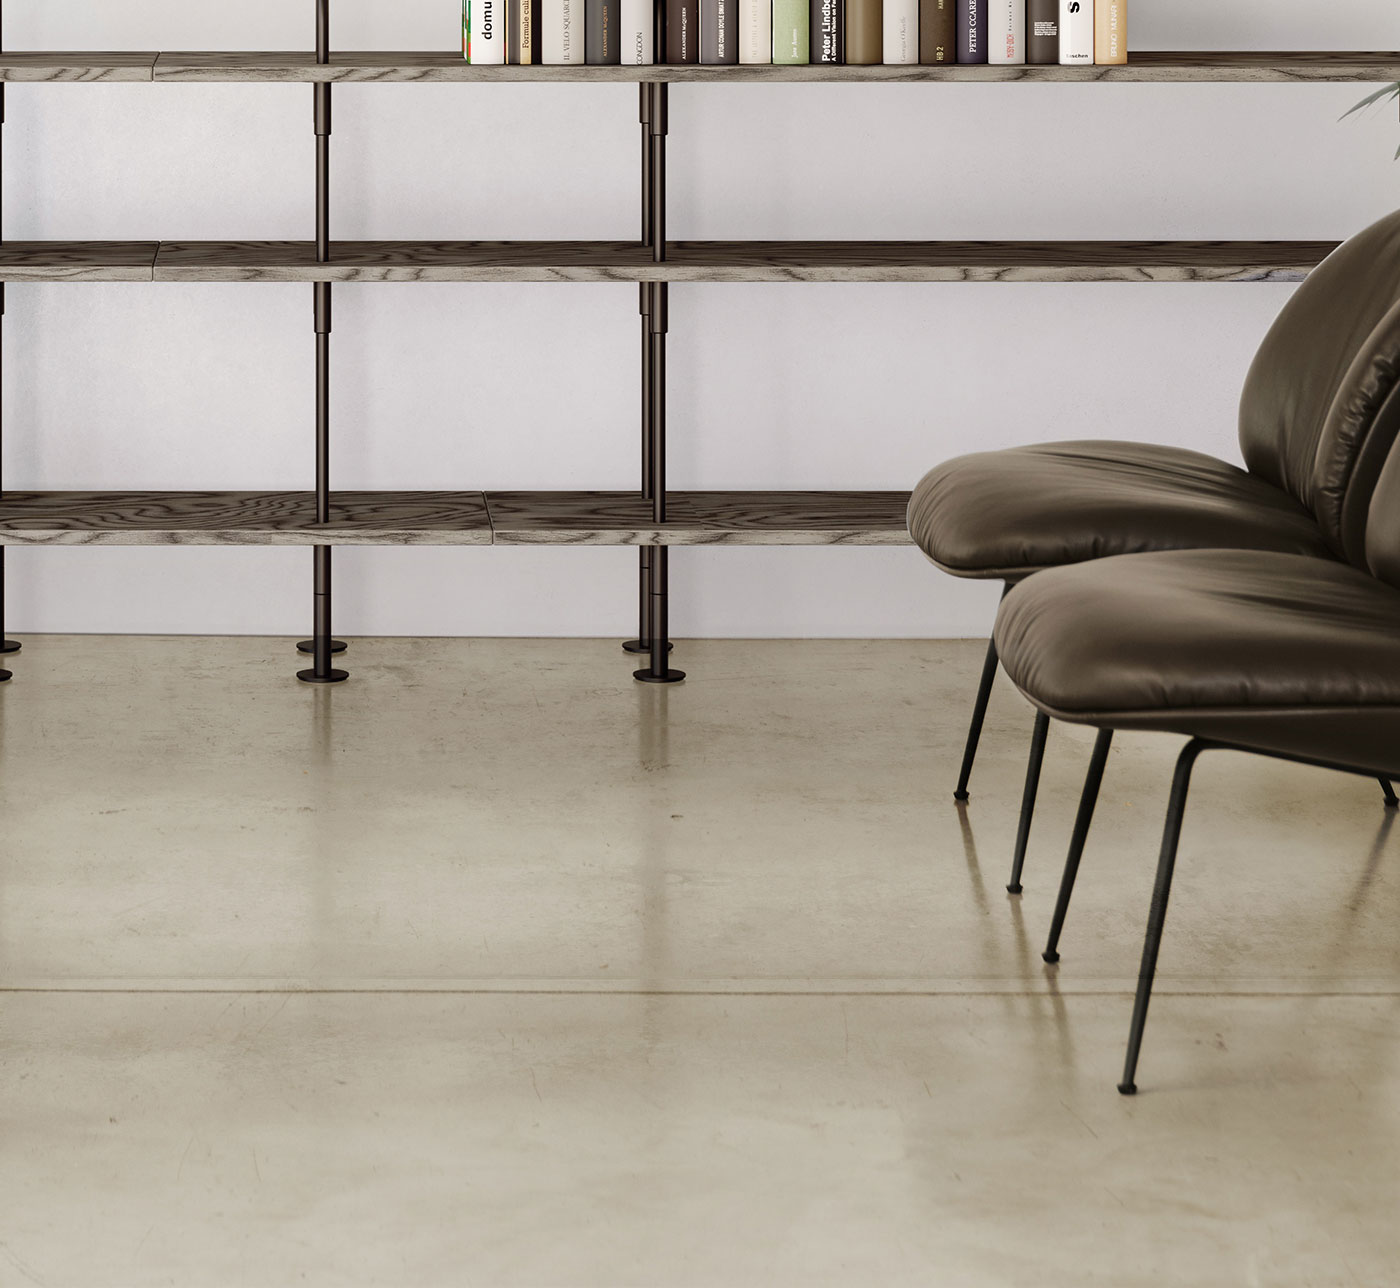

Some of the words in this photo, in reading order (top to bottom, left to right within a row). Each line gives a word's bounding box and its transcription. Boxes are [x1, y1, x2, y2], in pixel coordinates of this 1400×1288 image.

[522, 16, 530, 49] Formule
[969, 27, 977, 53] PETER
[821, 34, 831, 62] Peter
